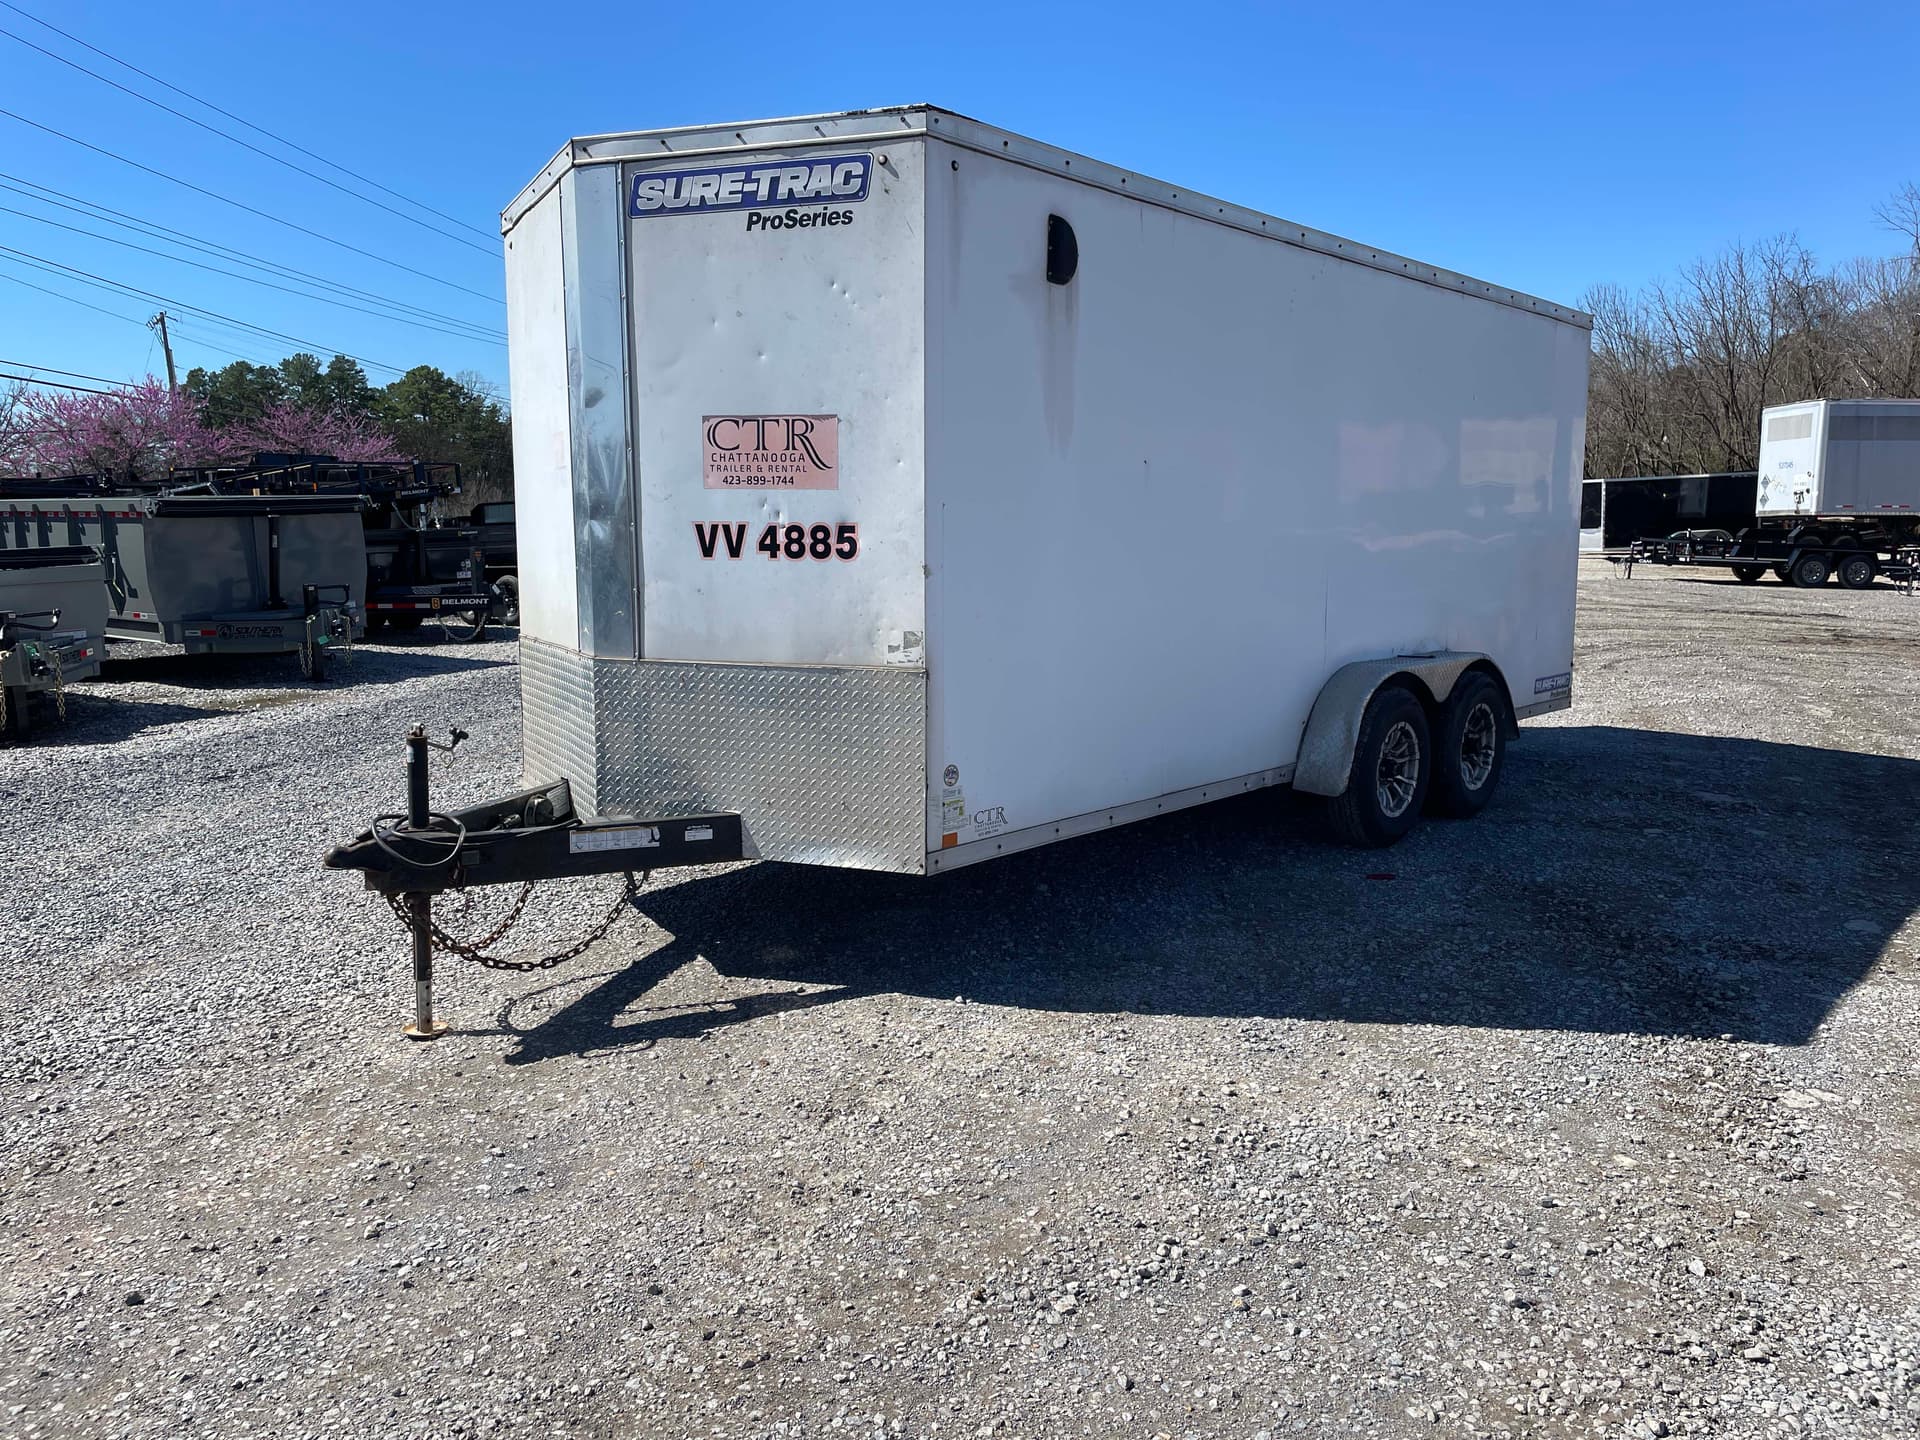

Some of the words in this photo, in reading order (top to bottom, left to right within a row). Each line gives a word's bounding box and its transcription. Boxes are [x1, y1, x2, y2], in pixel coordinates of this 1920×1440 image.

[636, 161, 865, 210] SURE-TRAC
[746, 206, 853, 231] ProSeries
[707, 418, 833, 471] CTR
[711, 452, 806, 463] CHATTANOOGA
[710, 464, 752, 473] TRAILER
[756, 464, 763, 473] &
[768, 464, 808, 473] RENTAL
[722, 475, 795, 486] 423-899-1744
[401, 488, 429, 496] BELMONT
[694, 522, 748, 559] VV
[757, 523, 858, 560] 4885
[441, 598, 490, 606] BELMONT
[974, 806, 1008, 824] CTR
